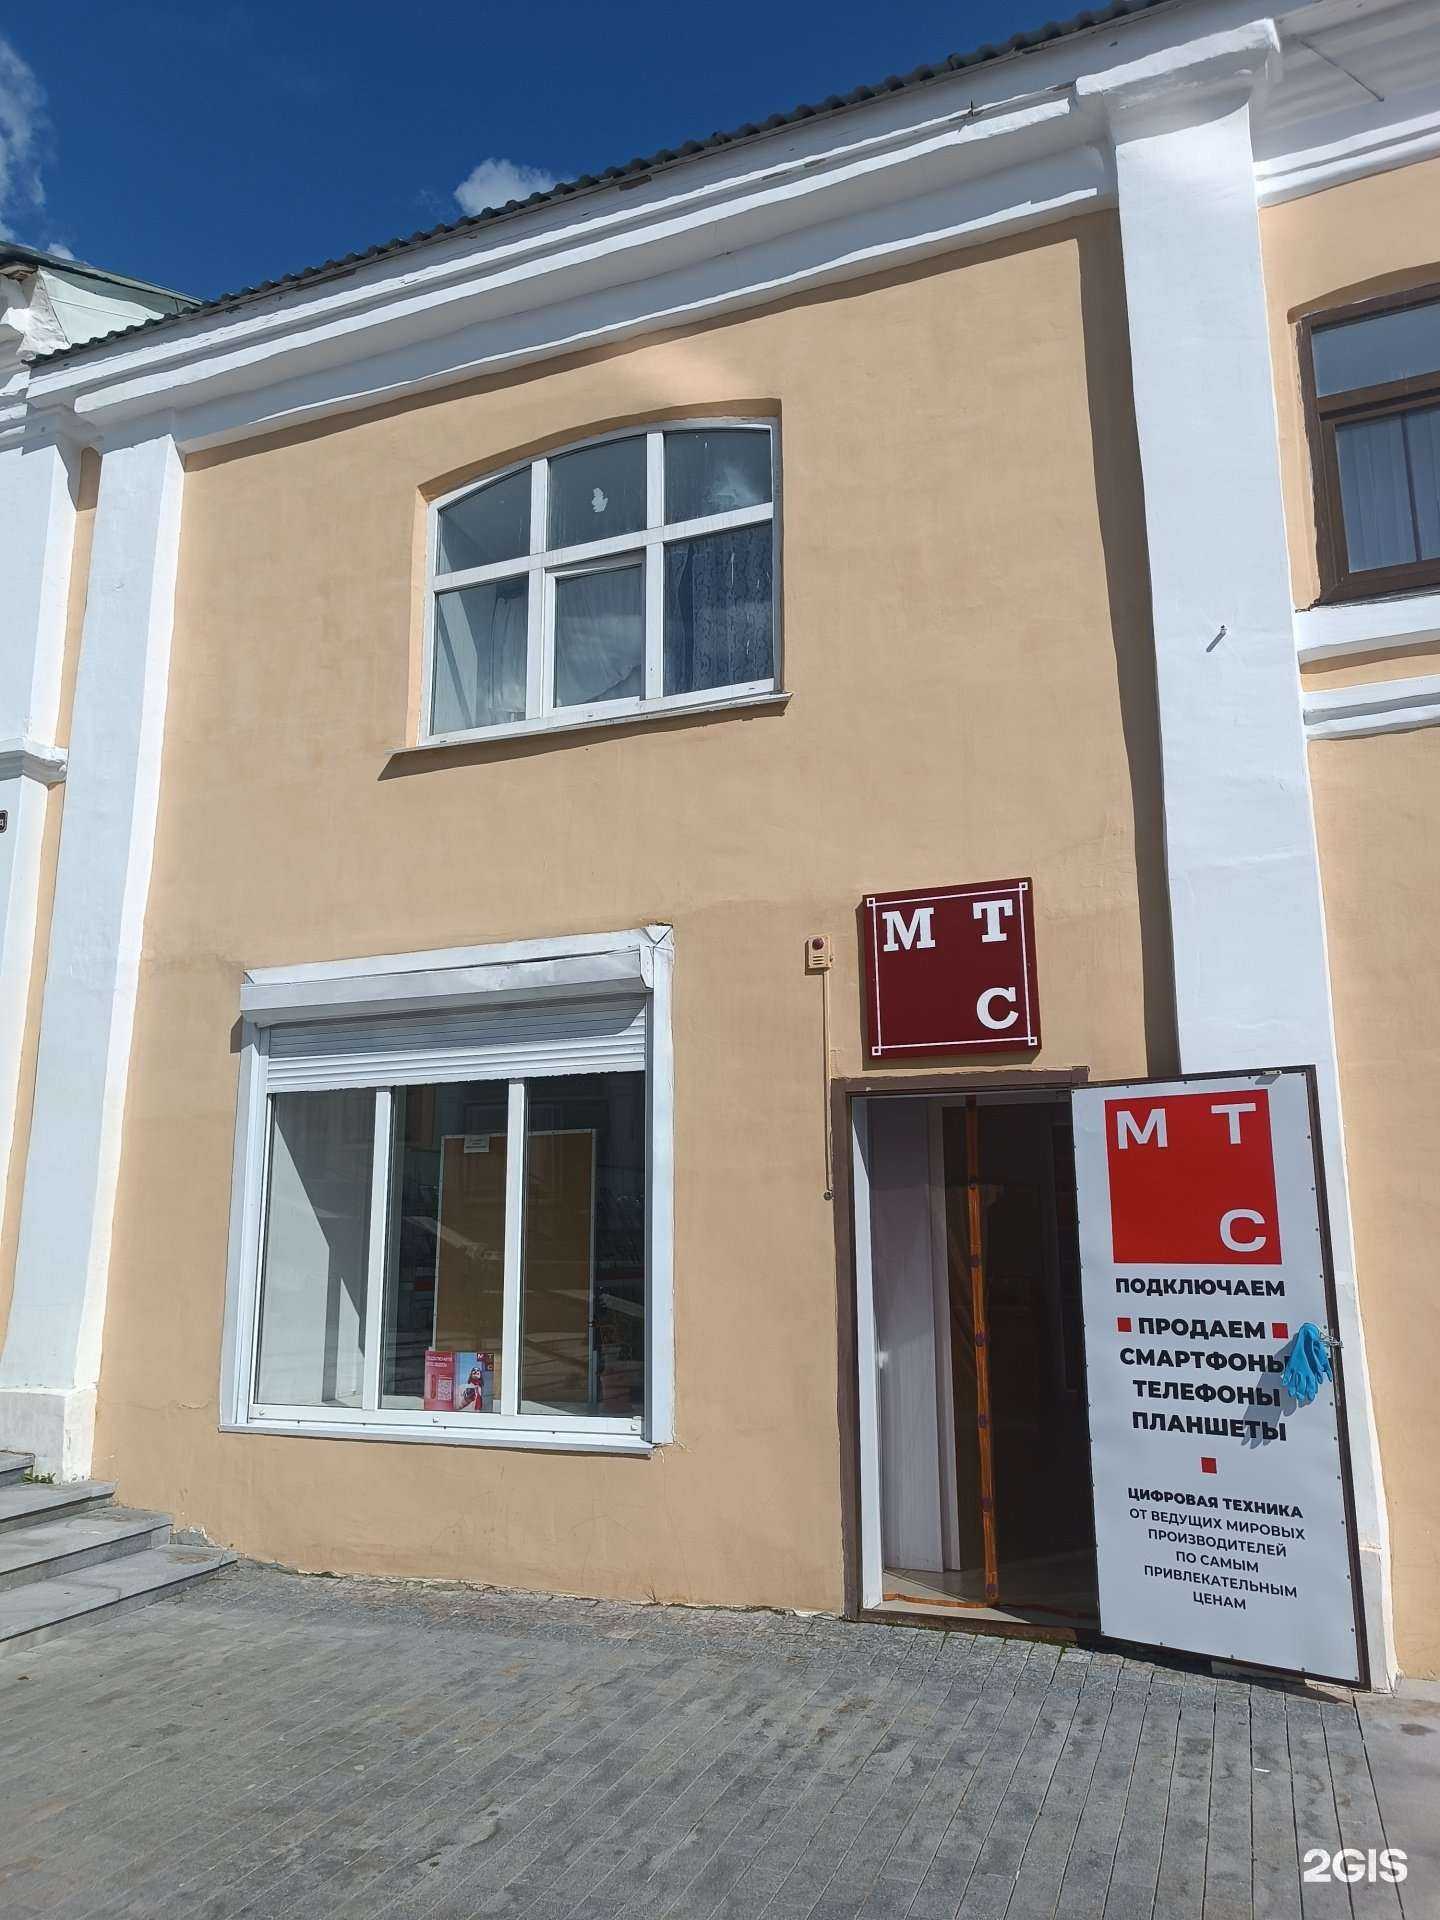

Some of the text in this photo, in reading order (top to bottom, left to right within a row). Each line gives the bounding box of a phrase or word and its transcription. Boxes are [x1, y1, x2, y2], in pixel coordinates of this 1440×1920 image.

[1115, 1278, 1285, 1297] ПОДКЛЮЧАЕМ
[1138, 1317, 1266, 1340] ПРОДАЕМ
[1132, 1379, 1281, 1407] ТЕЛЕФОНЫ
[1132, 1411, 1287, 1441] ПЛАНШЕТЫ
[1127, 1487, 1303, 1518] ЦИФРОВАЯ ТЕХНИКА
[1129, 1508, 1306, 1540] ОТ ВЕДУЩИХ МИРОВЫХ
[1147, 1528, 1287, 1557] ПРОИЗВОДИТЕЛЕЙ
[1175, 1550, 1259, 1574] ПО САМЫМ
[1143, 1565, 1298, 1598] ПРИВЛЕКАТЕЛЬНЫМ
[1192, 1590, 1247, 1611] ЦЕНАМ
